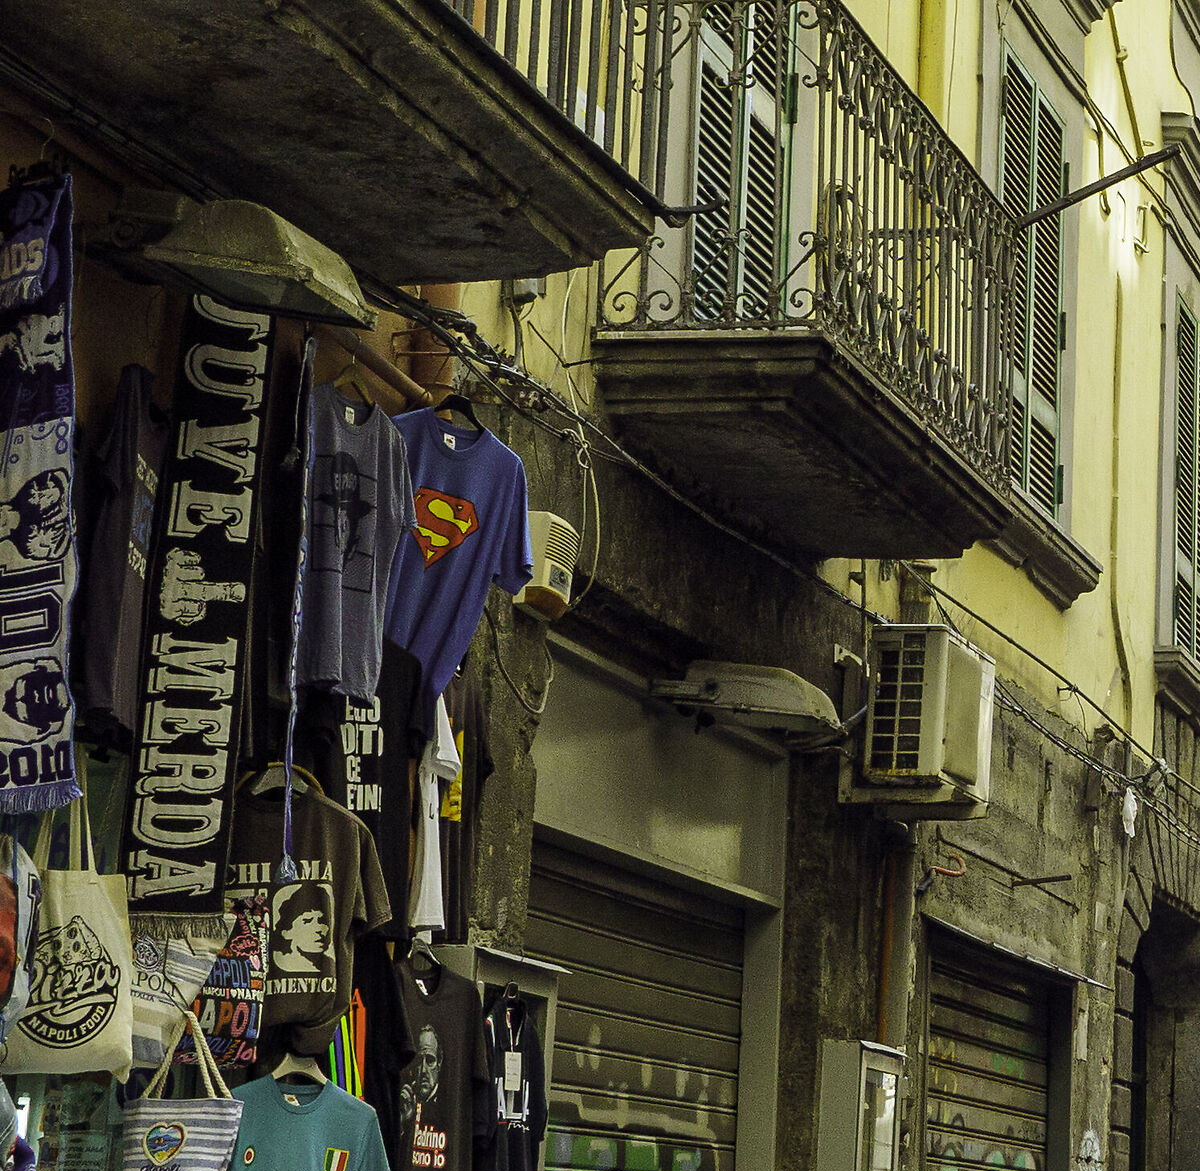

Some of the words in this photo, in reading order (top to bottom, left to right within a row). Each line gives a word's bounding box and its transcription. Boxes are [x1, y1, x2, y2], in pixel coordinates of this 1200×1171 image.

[167, 294, 270, 543] JUVE
[128, 632, 238, 900] MERDA
[28, 1015, 78, 1041] NAPOLI
[81, 1005, 106, 1034] FOOD
[262, 977, 336, 995] IMENTIC
